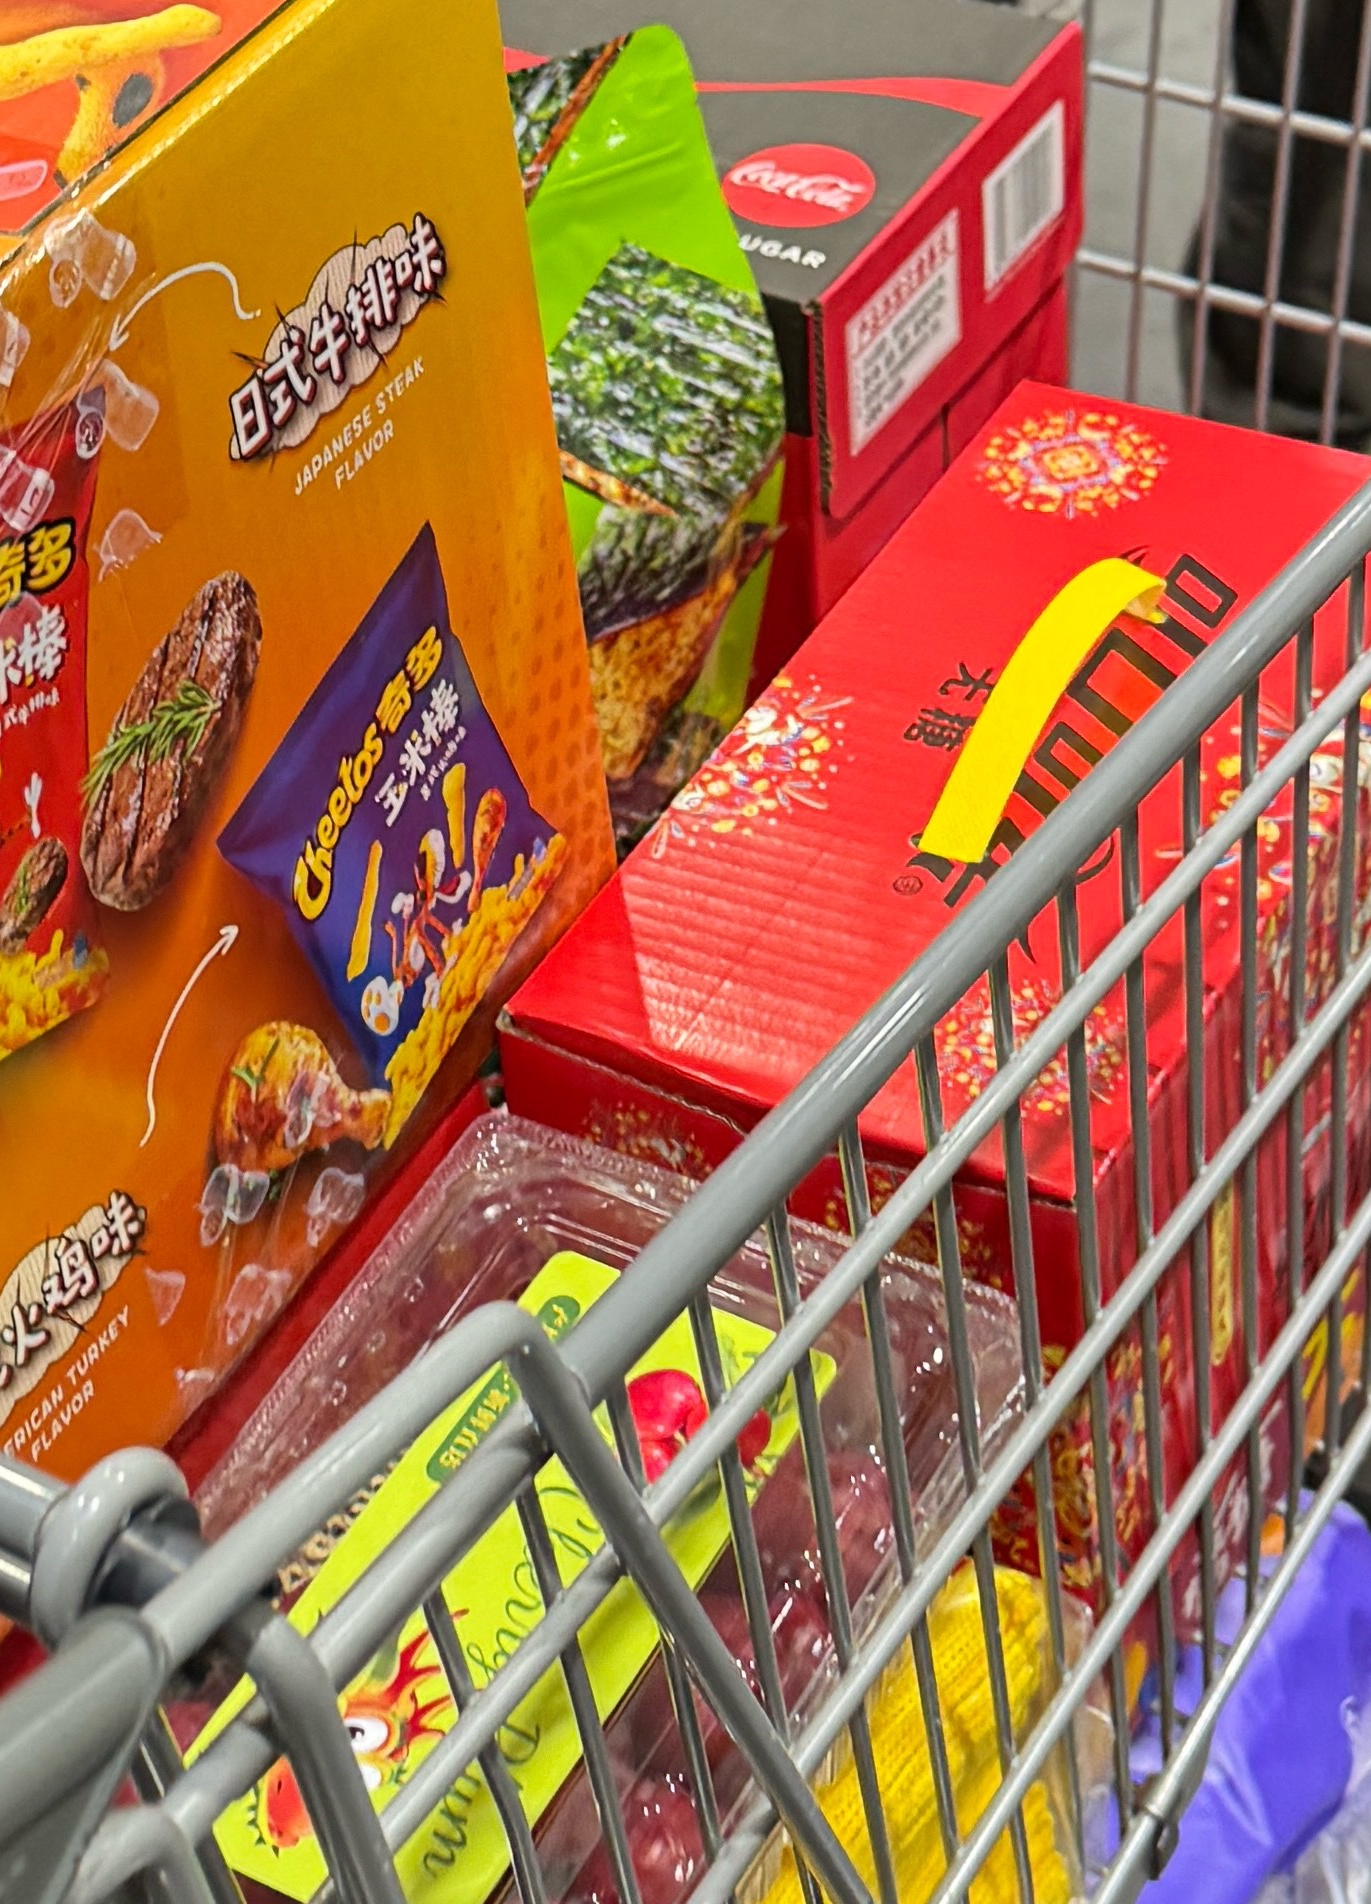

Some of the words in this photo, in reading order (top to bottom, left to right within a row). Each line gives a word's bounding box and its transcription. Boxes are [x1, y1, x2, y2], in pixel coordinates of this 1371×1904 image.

[738, 233, 827, 270] UGAR
[231, 212, 446, 459] 日式牛排味
[294, 406, 373, 495] JAPANESE
[375, 356, 426, 415] STEAK
[334, 419, 395, 490] FLAVOR
[374, 679, 460, 827] 玉米棒
[2, 1385, 64, 1457] ERICAN
[66, 1304, 130, 1385] TURKEY
[31, 1379, 96, 1462] FLAVOR
